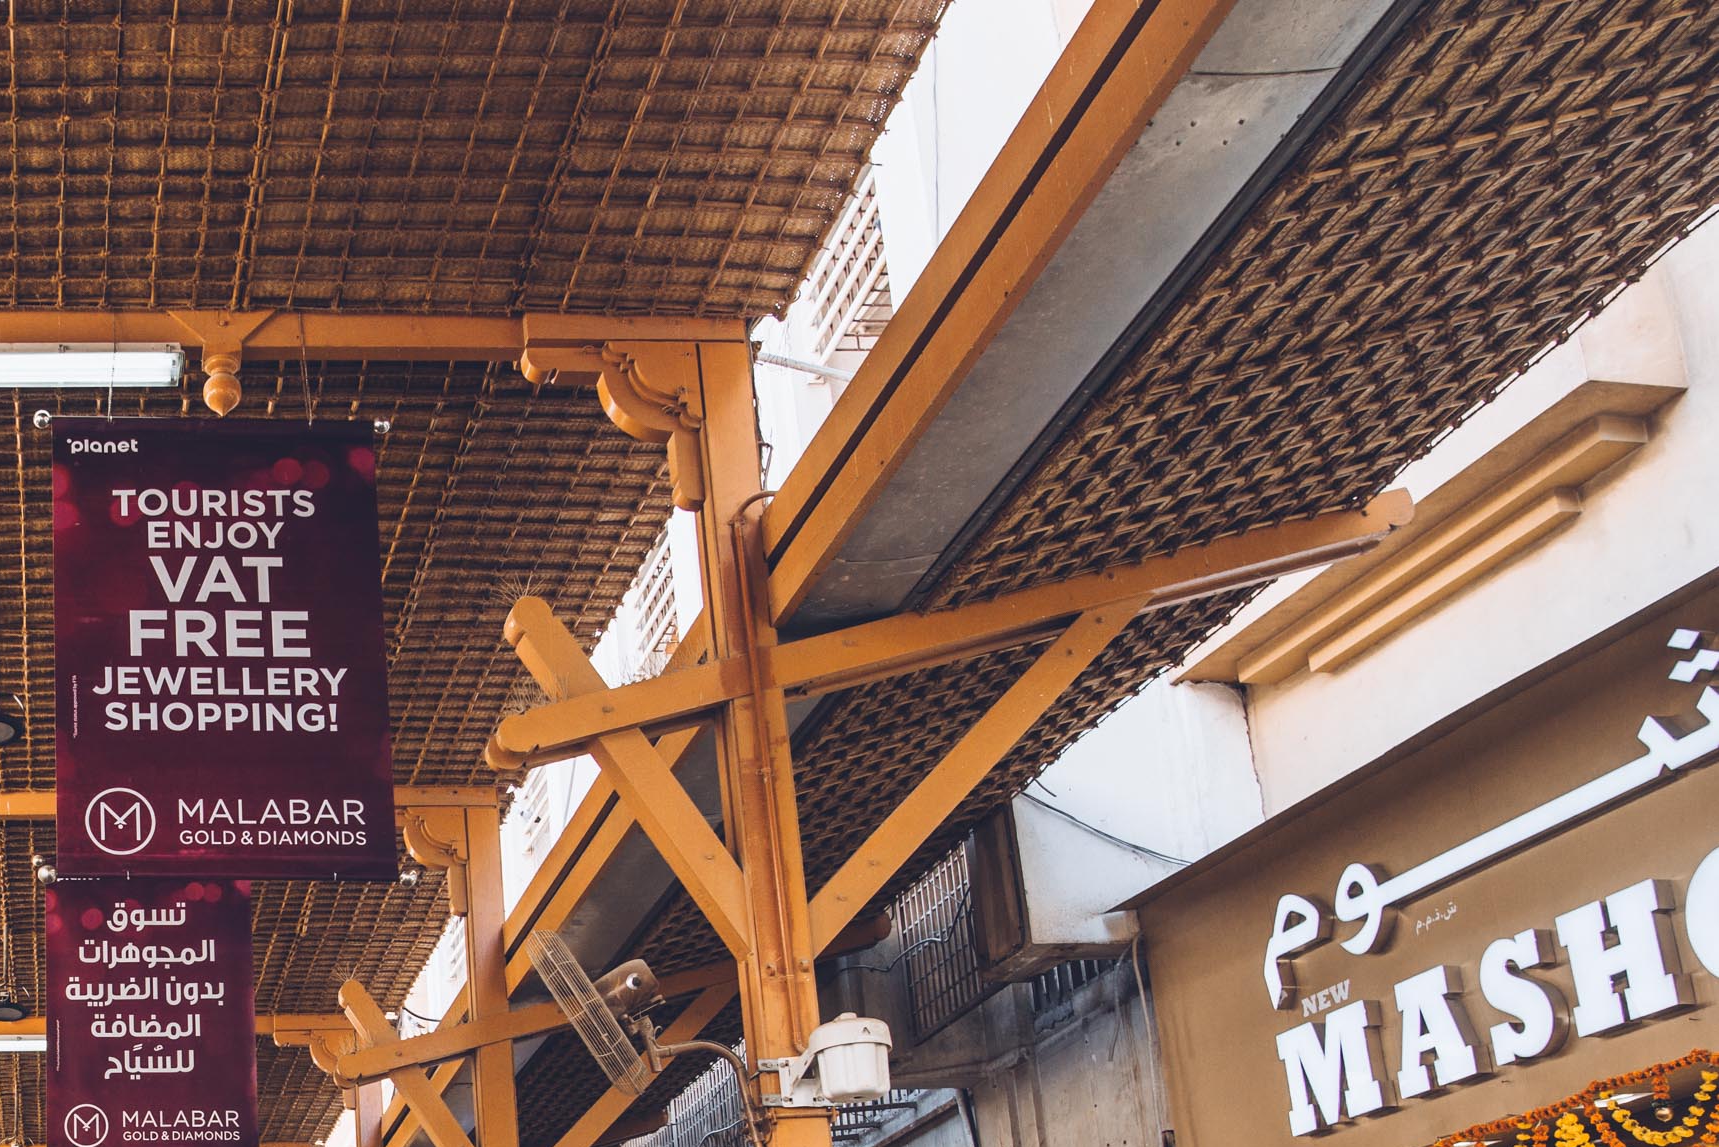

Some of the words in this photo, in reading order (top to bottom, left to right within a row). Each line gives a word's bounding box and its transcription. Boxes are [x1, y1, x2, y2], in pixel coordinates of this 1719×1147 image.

[67, 438, 138, 454] planet
[112, 489, 315, 517] TOURISTS
[148, 521, 284, 549] ENJOY
[149, 556, 283, 603] VAT
[129, 610, 311, 657] FREE
[92, 667, 348, 696] JEWELLERY
[105, 703, 338, 732] SHOPPING!
[178, 799, 366, 826] MALABAR
[179, 830, 236, 846] GOLD
[241, 830, 254, 846] &
[258, 830, 367, 846] DIAMONDS
[106, 902, 186, 932] تسوق
[78, 939, 215, 969] المجوهرات
[65, 976, 159, 1007] الضريبة
[165, 975, 225, 1006] بدون
[1301, 979, 1351, 1018] NEW
[90, 1013, 201, 1040] المضافة
[122, 1110, 240, 1128] MALABAR
[123, 1131, 159, 1141] GOLD
[161, 1131, 170, 1141] &
[172, 1130, 241, 1141] DIAMONDS
